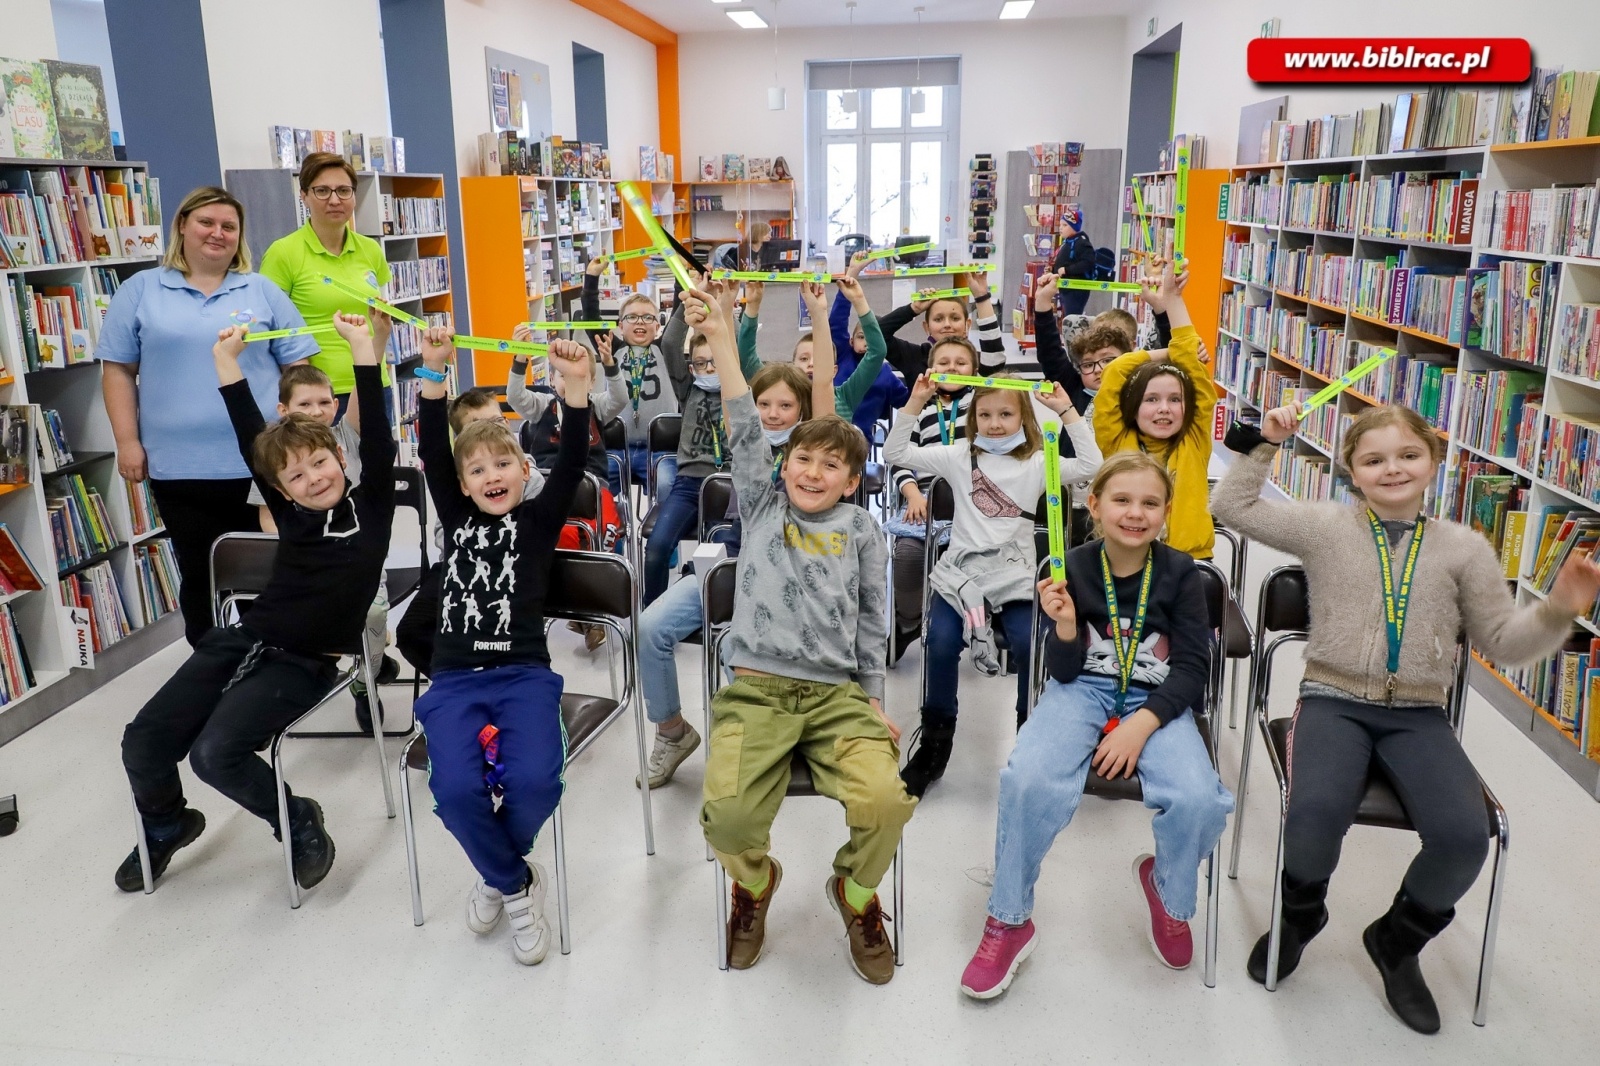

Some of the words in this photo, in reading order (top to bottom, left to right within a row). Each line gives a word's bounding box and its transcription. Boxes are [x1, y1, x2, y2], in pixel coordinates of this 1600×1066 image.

[14, 109, 43, 128] LASU
[1460, 190, 1475, 234] MANGA
[1393, 271, 1405, 318] ZWIERZĘTA
[1380, 546, 1392, 595] PODSTAWOWA
[1403, 540, 1419, 583] PODSTAWOWA
[76, 628, 88, 667] NAUKA
[474, 640, 512, 651] FORTNITE
[1111, 616, 1125, 666] PODSTAWOWA
[1565, 662, 1575, 685] SMOK
